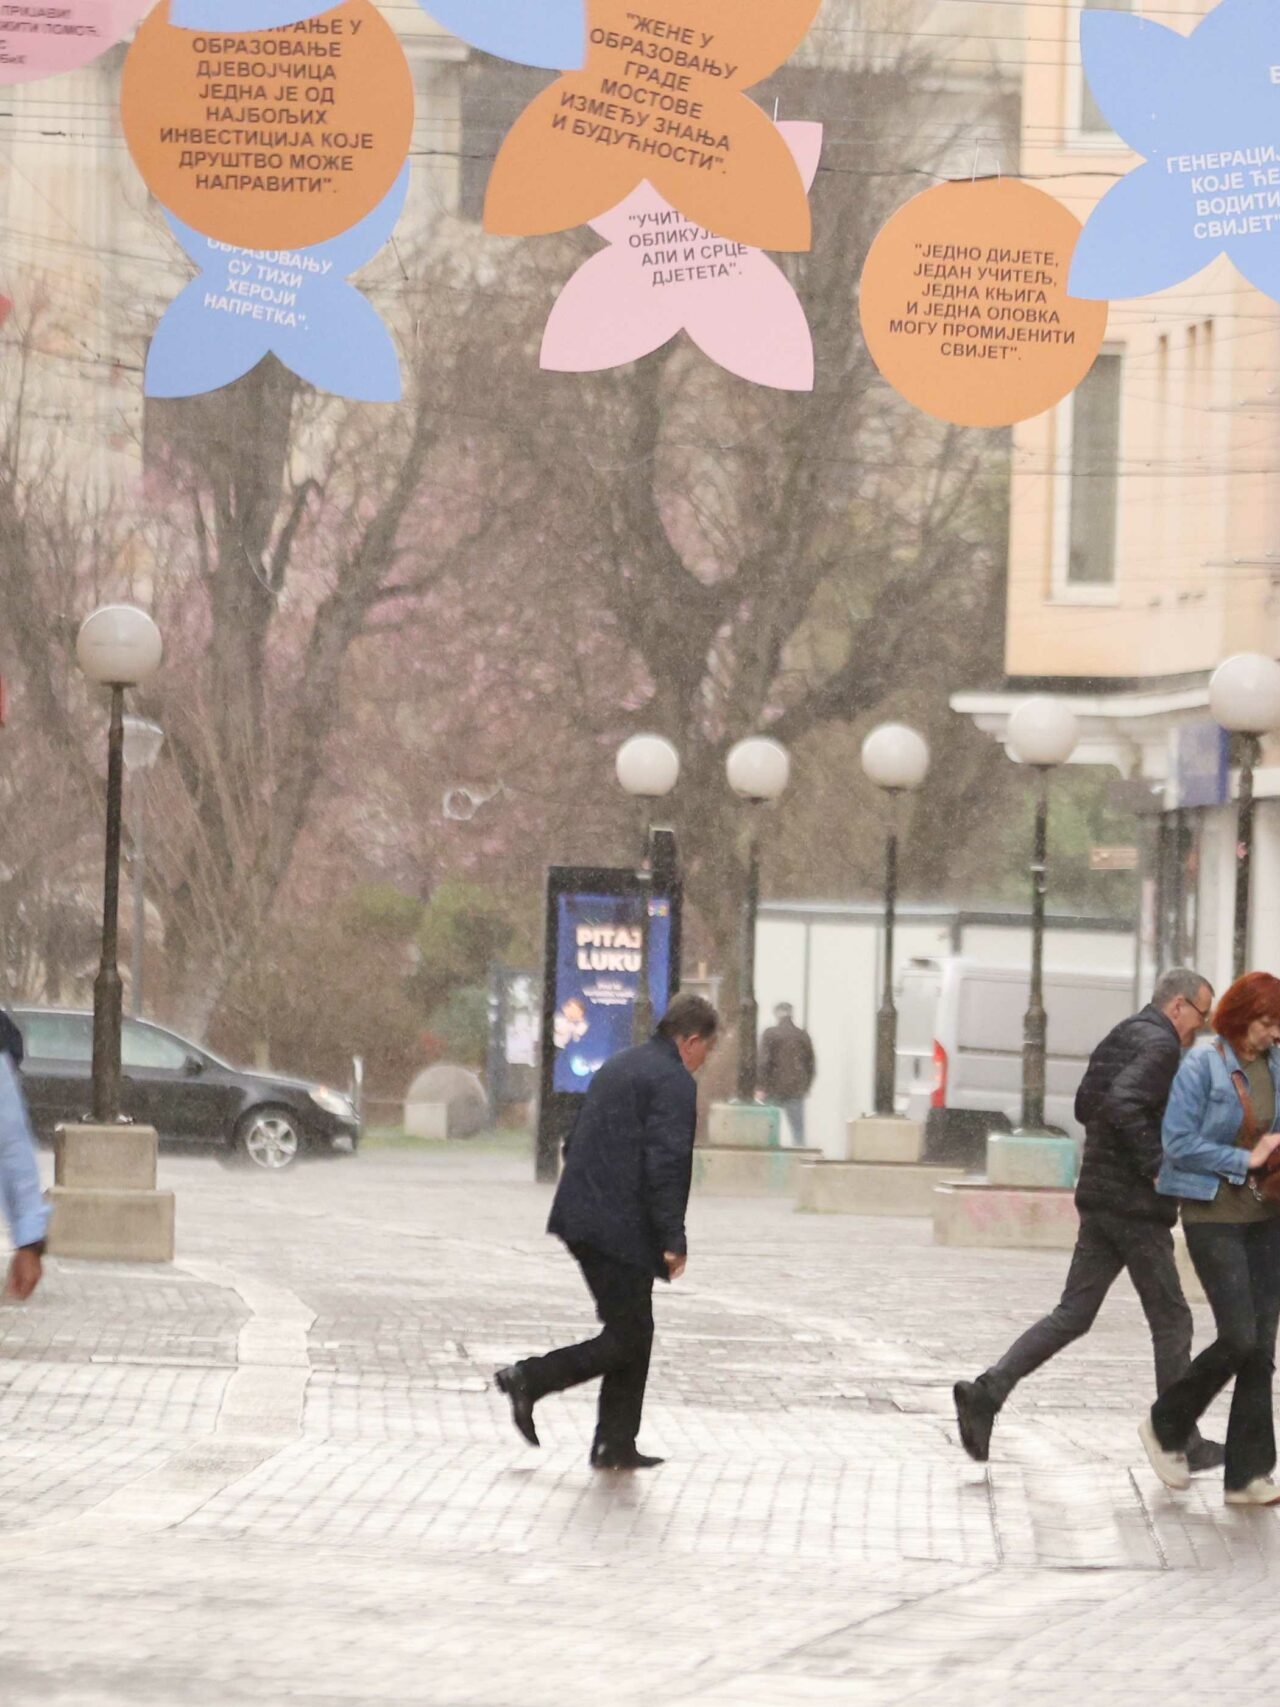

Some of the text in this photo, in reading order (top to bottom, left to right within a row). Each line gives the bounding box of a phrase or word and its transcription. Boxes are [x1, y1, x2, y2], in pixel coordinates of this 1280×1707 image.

[626, 12, 714, 49] "ЖЕНЕ У
[192, 37, 342, 57] ОБРАЗОВАЊЕ
[589, 28, 738, 80] ОБРАЗОВАЊУ
[196, 60, 337, 80] ДЈЕВОЈЧИЦА
[624, 61, 691, 92] ГРАДЕ
[199, 84, 335, 105] ЈЕДНА ЈЕ ОД
[600, 78, 703, 120] МОСТОВЕ
[206, 106, 328, 126] НАЈБОЉИХ
[551, 114, 567, 131] И
[560, 91, 730, 151] ИЗМЕЂУ ЗНАЊА
[160, 128, 374, 149] ИНВЕСТИЦИЈА КОЈЕ
[178, 150, 354, 172] ДРУШТВО МОЖЕ
[1190, 171, 1245, 195] КОЈЕ
[641, 243, 748, 267] АЛИ И СРЦЕ
[914, 243, 1059, 267] "ЈЕДНО ДИЈЕТЕ,
[228, 259, 303, 288] СУ ТИХИ
[913, 263, 1057, 287] ЈЕДАН УЧИТЕЉ,
[226, 278, 297, 307] ХЕРОЈИ
[922, 283, 1047, 304] ЈЕДНА КЊИГА
[906, 301, 1060, 324] И ЈЕДНА ОЛОВКА
[889, 319, 1075, 345] МОГУ ПРОМИЈЕНИТИ
[575, 925, 643, 949] PITAJ
[576, 951, 643, 973] LUKU
